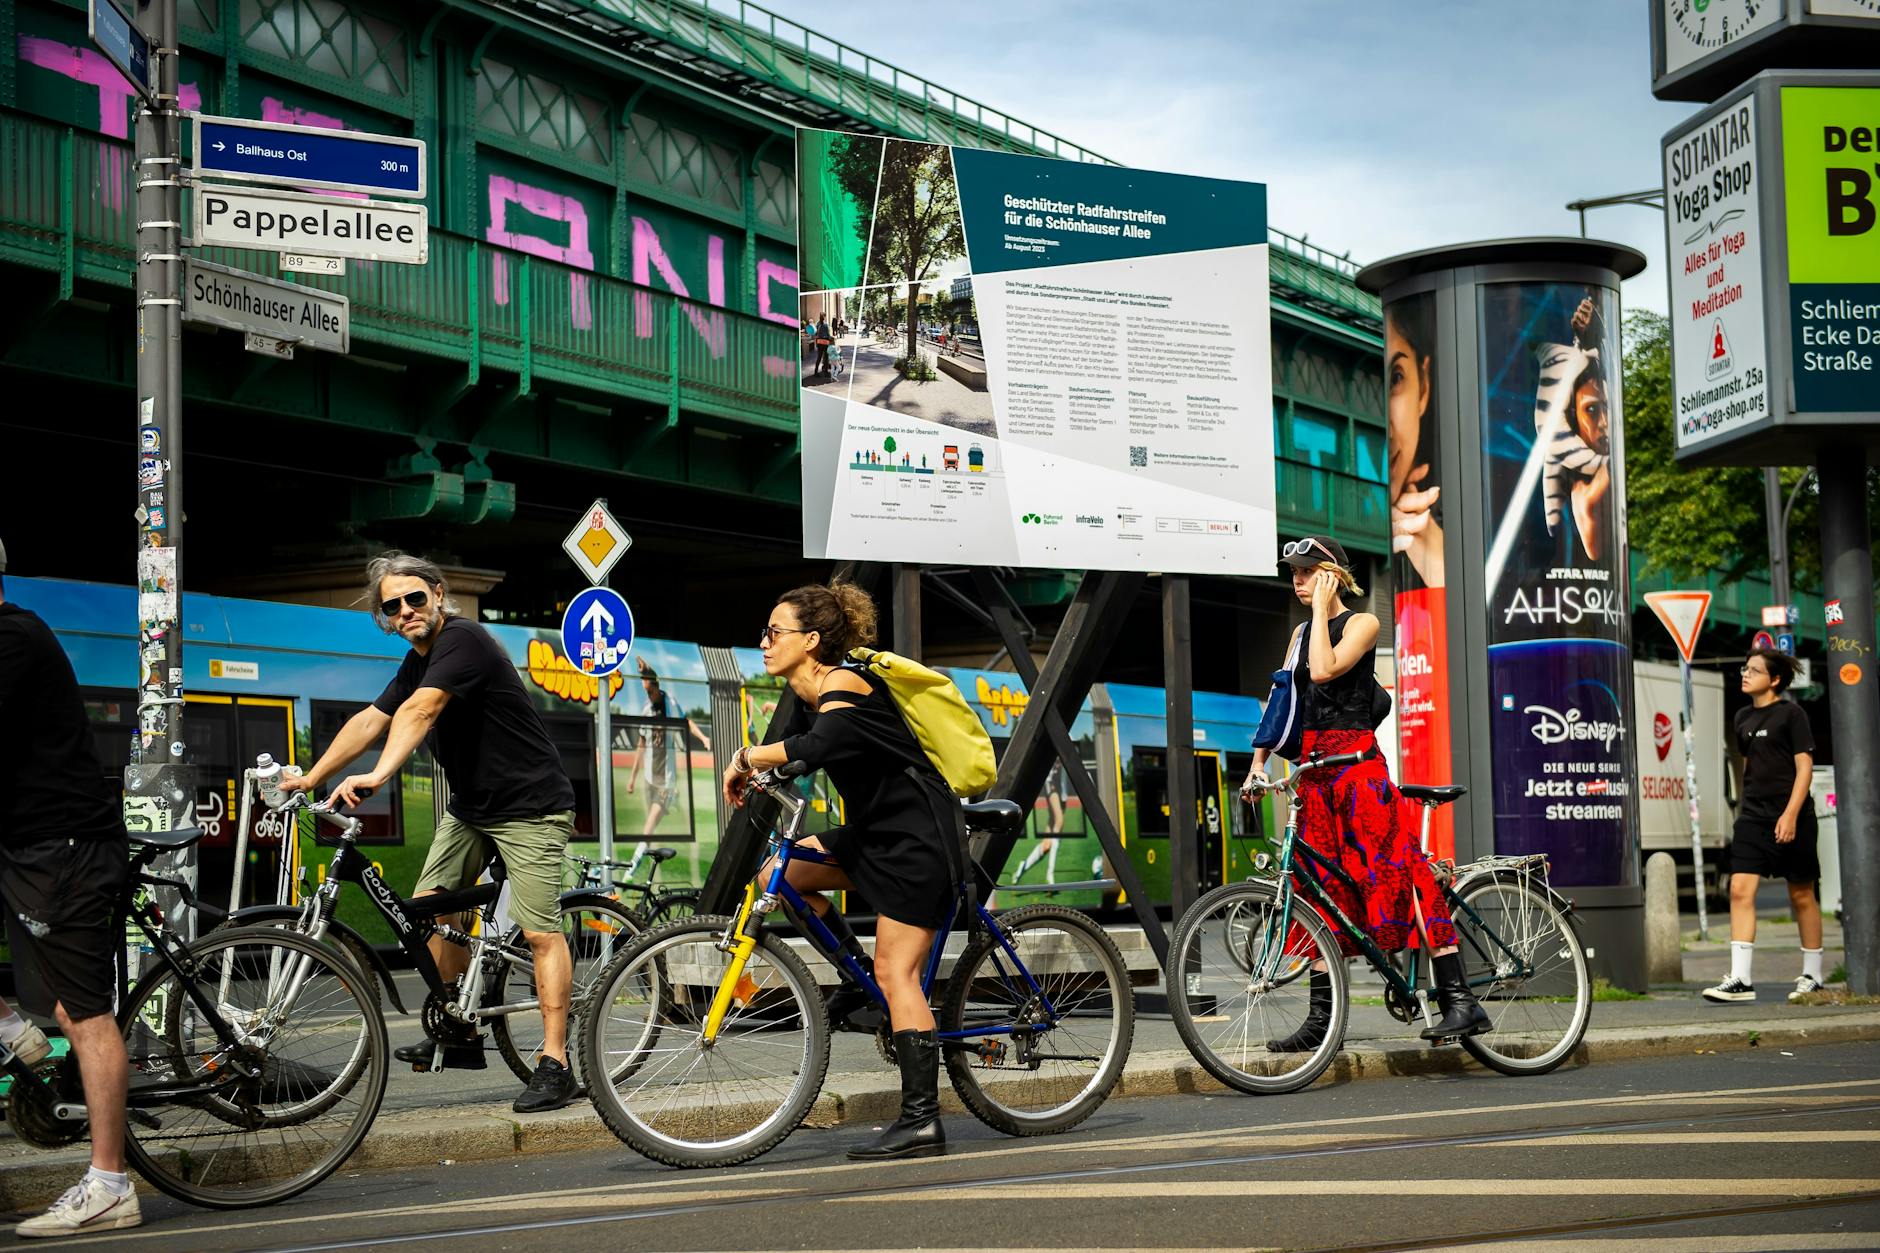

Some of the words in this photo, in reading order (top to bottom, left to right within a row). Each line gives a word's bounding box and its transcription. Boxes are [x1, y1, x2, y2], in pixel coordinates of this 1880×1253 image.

[1722, 16, 1728, 30] 6
[236, 143, 284, 160] Ballhaus
[287, 147, 307, 162] Ost
[1672, 106, 1750, 187] SOTANTAR
[380, 160, 398, 172] 300
[400, 164, 409, 173] m
[1673, 184, 1708, 223] Yoga
[1713, 160, 1751, 202] Shop
[1825, 157, 1880, 236] B
[206, 198, 414, 244] Pappelallee
[1004, 194, 1074, 215] Geschützter
[1077, 202, 1165, 225] Radfahrstreifen
[1004, 210, 1021, 226] für
[1024, 212, 1042, 228] die
[1045, 215, 1119, 236] Schönhauser
[1122, 223, 1151, 240] Allee
[1013, 243, 1030, 251] August
[1685, 253, 1706, 276] Alles
[1708, 242, 1721, 264] für
[1722, 231, 1745, 255] Yoga
[288, 256, 303, 268] 89
[326, 259, 338, 270] 73
[1707, 263, 1724, 288] und
[193, 274, 295, 324] Schönhauser
[300, 301, 340, 333] Allee
[1692, 283, 1742, 320] Meditation
[253, 337, 264, 348] 45
[1803, 325, 1850, 346] Ecke
[1803, 350, 1872, 372] Straße
[1681, 376, 1743, 414] Schliemannstr.
[1745, 368, 1763, 389] 25a
[1075, 514, 1104, 525] infraVelo
[1546, 568, 1583, 580] STAR
[1583, 568, 1610, 580] WARS
[1504, 587, 1626, 625] AHSOKA
[1543, 762, 1564, 774] DIE
[1567, 762, 1595, 774] NEUE
[1598, 762, 1621, 774] SERIE
[1524, 779, 1574, 797] Jetzt
[1642, 776, 1684, 800] SELGROS
[1545, 803, 1622, 820] streamen
[364, 866, 412, 933] bodytec
